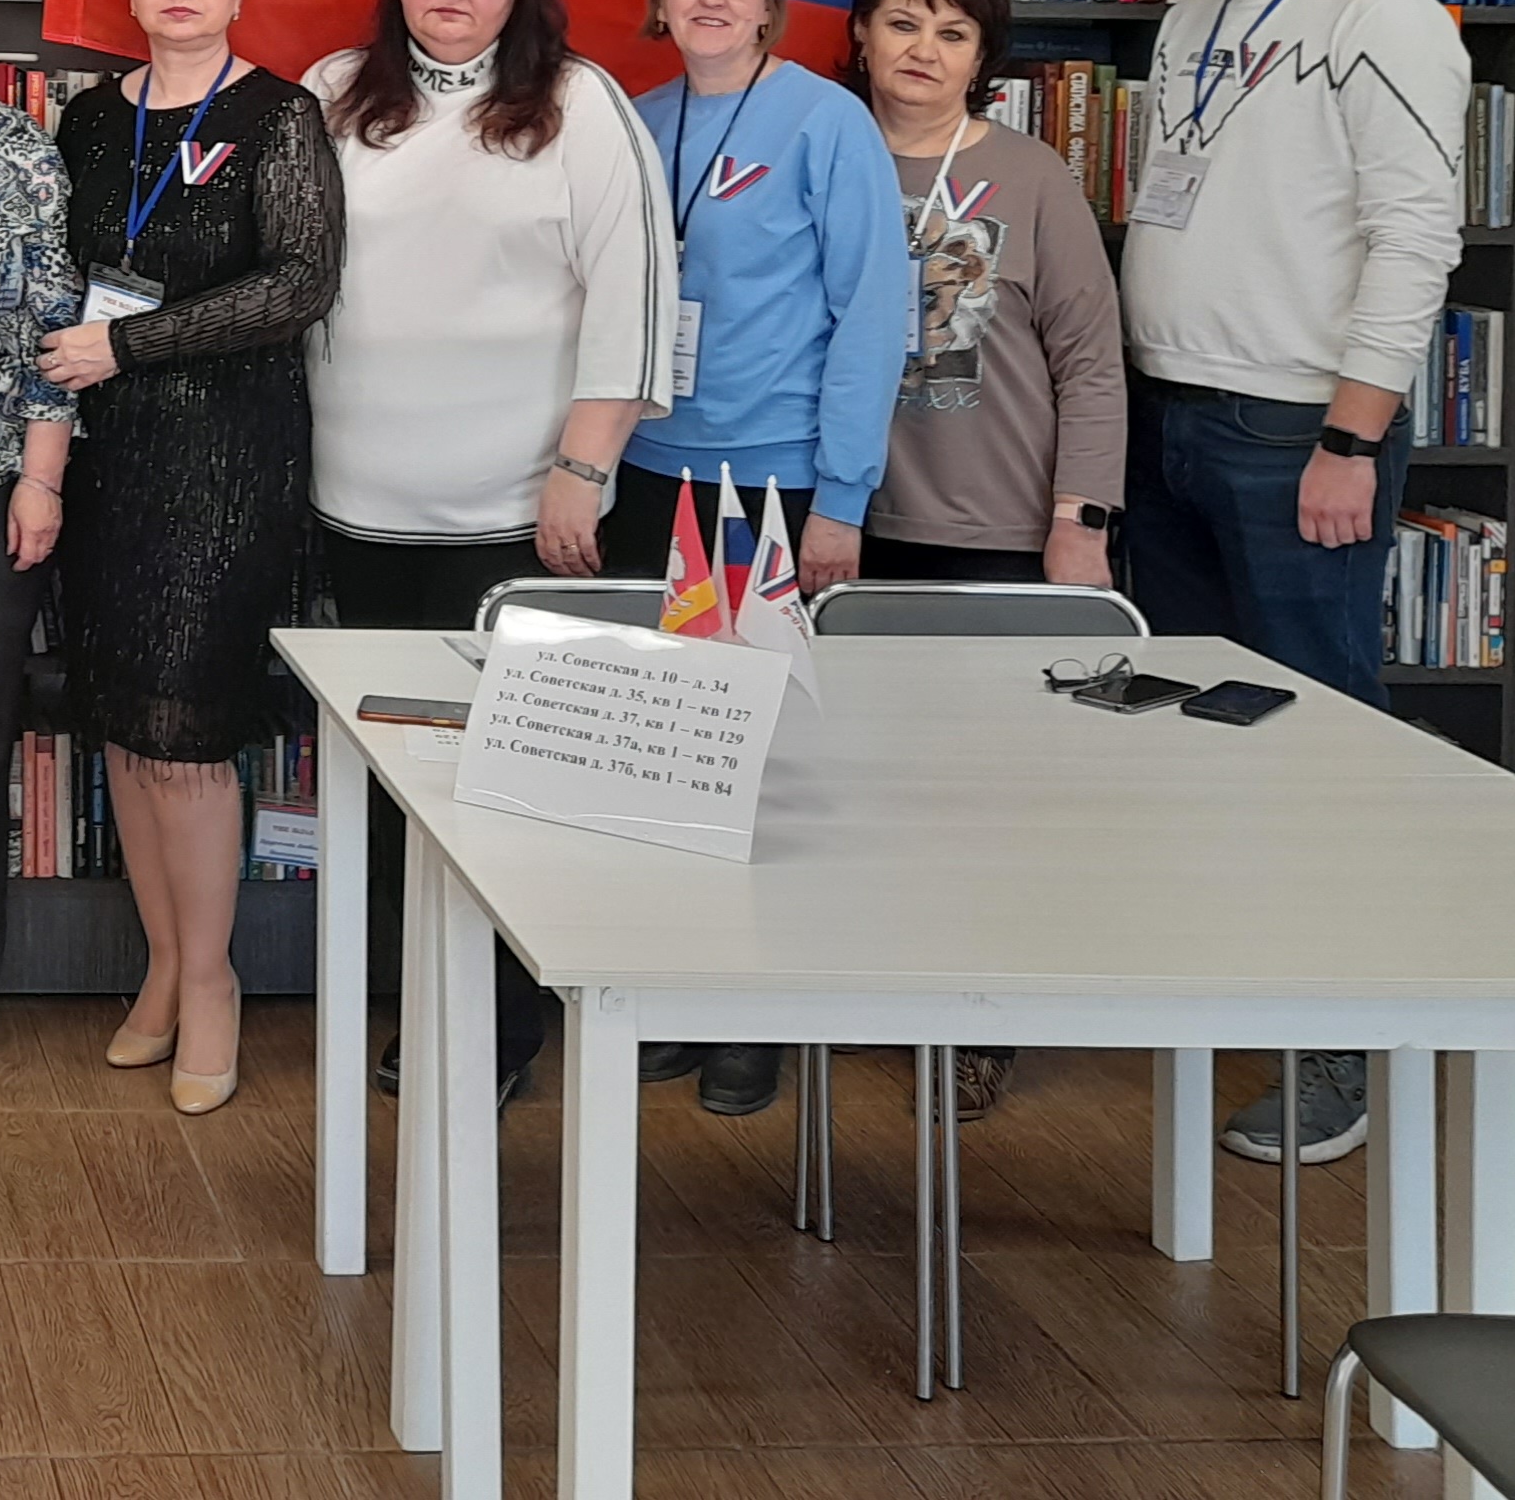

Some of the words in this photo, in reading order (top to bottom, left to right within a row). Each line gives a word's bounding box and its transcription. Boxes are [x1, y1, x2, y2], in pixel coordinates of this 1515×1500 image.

[1067, 71, 1089, 133] СТАТИСТИКА
[504, 667, 526, 681] ул.
[529, 670, 606, 696] Советская
[609, 685, 623, 698] д.
[626, 688, 647, 705] 35,
[652, 695, 671, 708] кв
[675, 697, 683, 710] 1
[701, 704, 720, 718] кв
[725, 706, 752, 723] 127
[536, 649, 558, 664] ул.
[562, 651, 640, 678] Советская
[642, 669, 656, 681] д.
[662, 670, 678, 685] 10
[692, 678, 706, 691] д.
[710, 679, 729, 694] 34
[489, 711, 512, 726] ул.
[515, 715, 592, 742] Советская
[595, 731, 609, 745] д.
[612, 734, 642, 753] 37а,
[647, 743, 666, 756] кв
[671, 744, 679, 758] 1
[696, 752, 715, 766] кв
[720, 756, 737, 771] 70
[496, 689, 518, 702] ул.
[522, 692, 599, 718] Советская
[602, 707, 616, 721] д.
[619, 711, 640, 728] 37,
[645, 718, 664, 730] кв
[668, 719, 676, 733] 1
[693, 726, 713, 740] кв
[718, 729, 745, 746] 129
[484, 736, 506, 751] ул.
[509, 739, 587, 767] Советская
[590, 757, 604, 771] д.
[607, 758, 637, 779] 37б,
[642, 768, 661, 782] кв
[666, 770, 674, 784] 1
[691, 778, 710, 792] кв
[715, 780, 733, 797] 84
